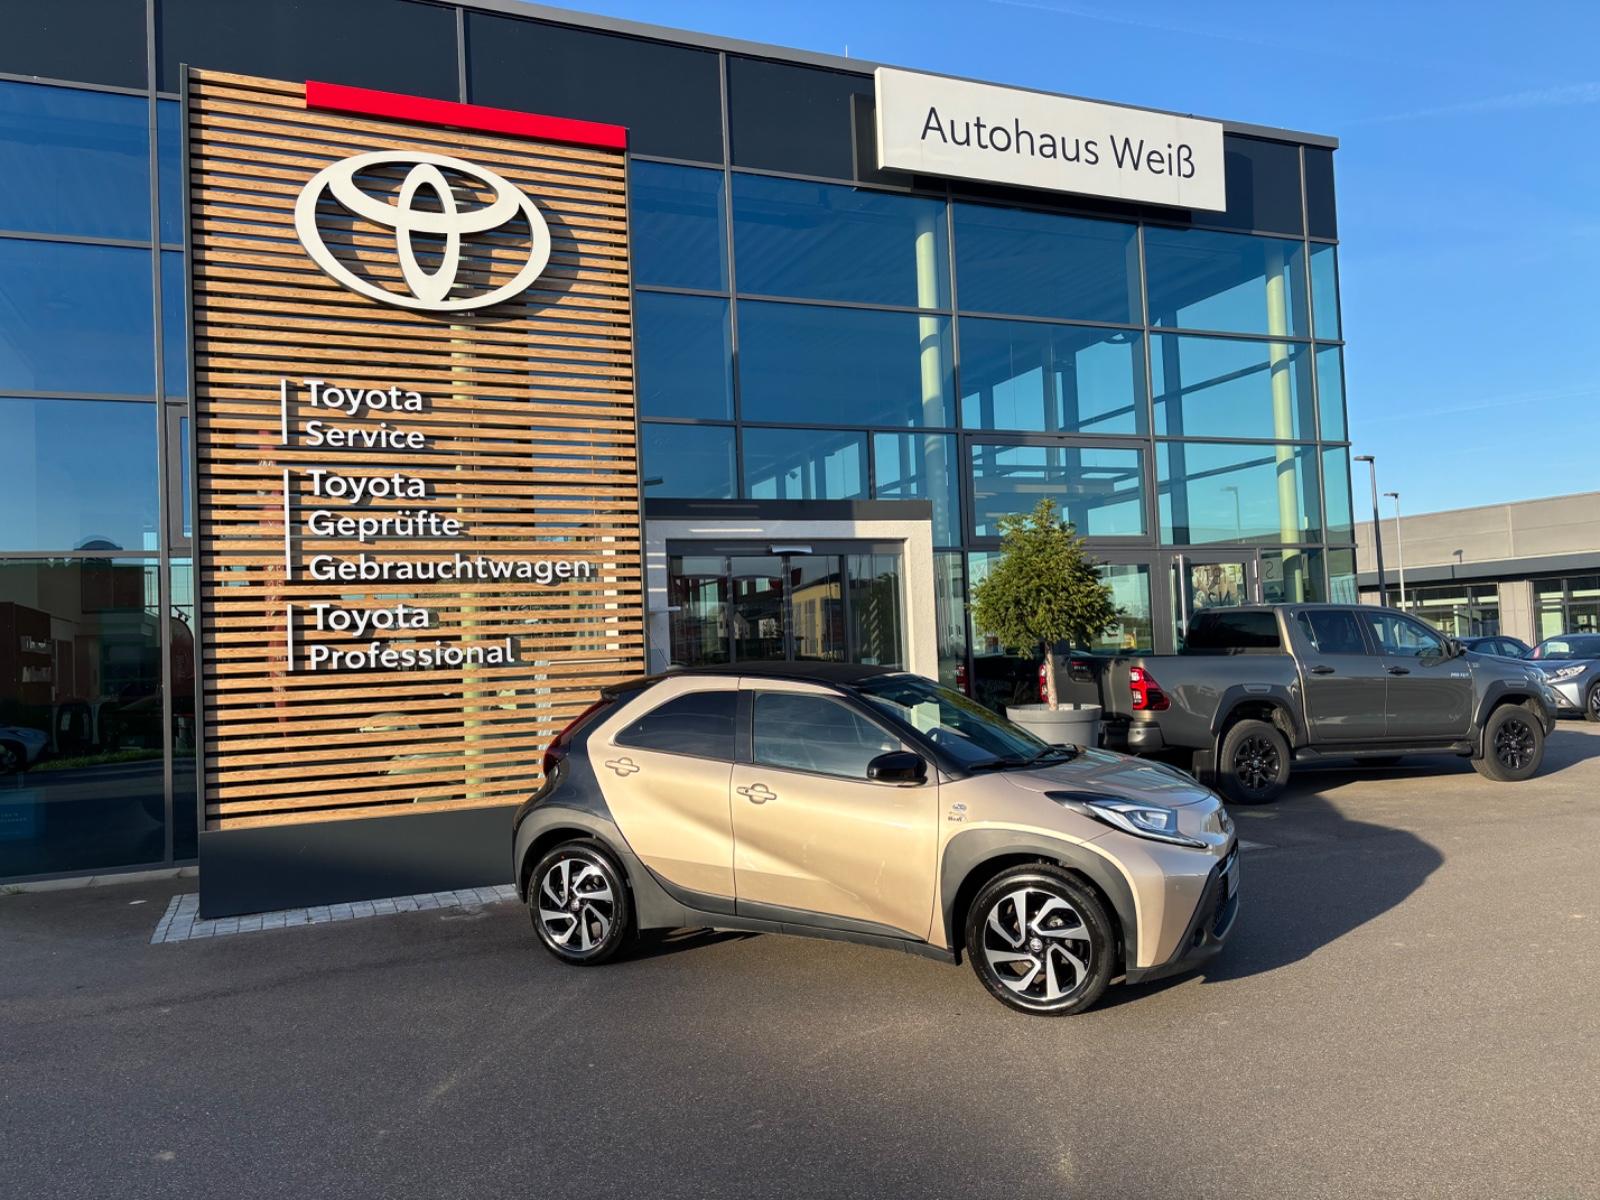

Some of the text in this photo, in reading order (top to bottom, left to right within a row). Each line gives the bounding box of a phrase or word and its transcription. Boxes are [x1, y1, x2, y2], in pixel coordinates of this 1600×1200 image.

[920, 106, 1195, 179] Autohaus Weiß
[303, 379, 423, 415] Toyota
[305, 420, 425, 449] Service
[306, 468, 426, 504] Toyota
[308, 510, 461, 541] Geprüfte
[309, 553, 590, 584] Gebrauchtwagen
[310, 603, 429, 637] Toyota
[310, 637, 515, 670] Professional
